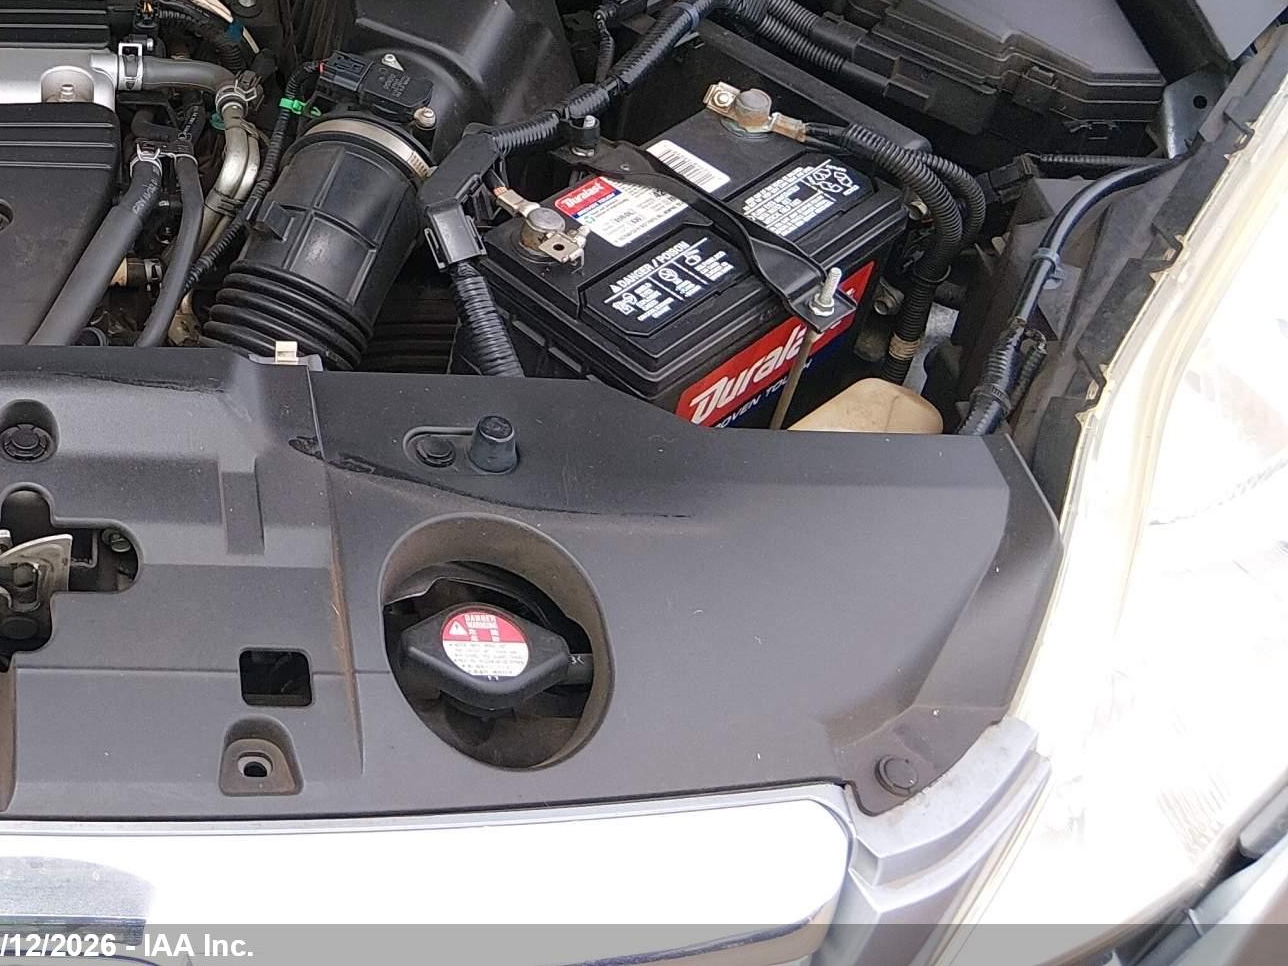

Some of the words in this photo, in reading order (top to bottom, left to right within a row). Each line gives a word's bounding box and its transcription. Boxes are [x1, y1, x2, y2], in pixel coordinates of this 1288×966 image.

[616, 263, 654, 288] DANGER
[657, 240, 691, 264] POISON
[690, 308, 838, 425] Durala
[714, 393, 762, 428] OVEN
